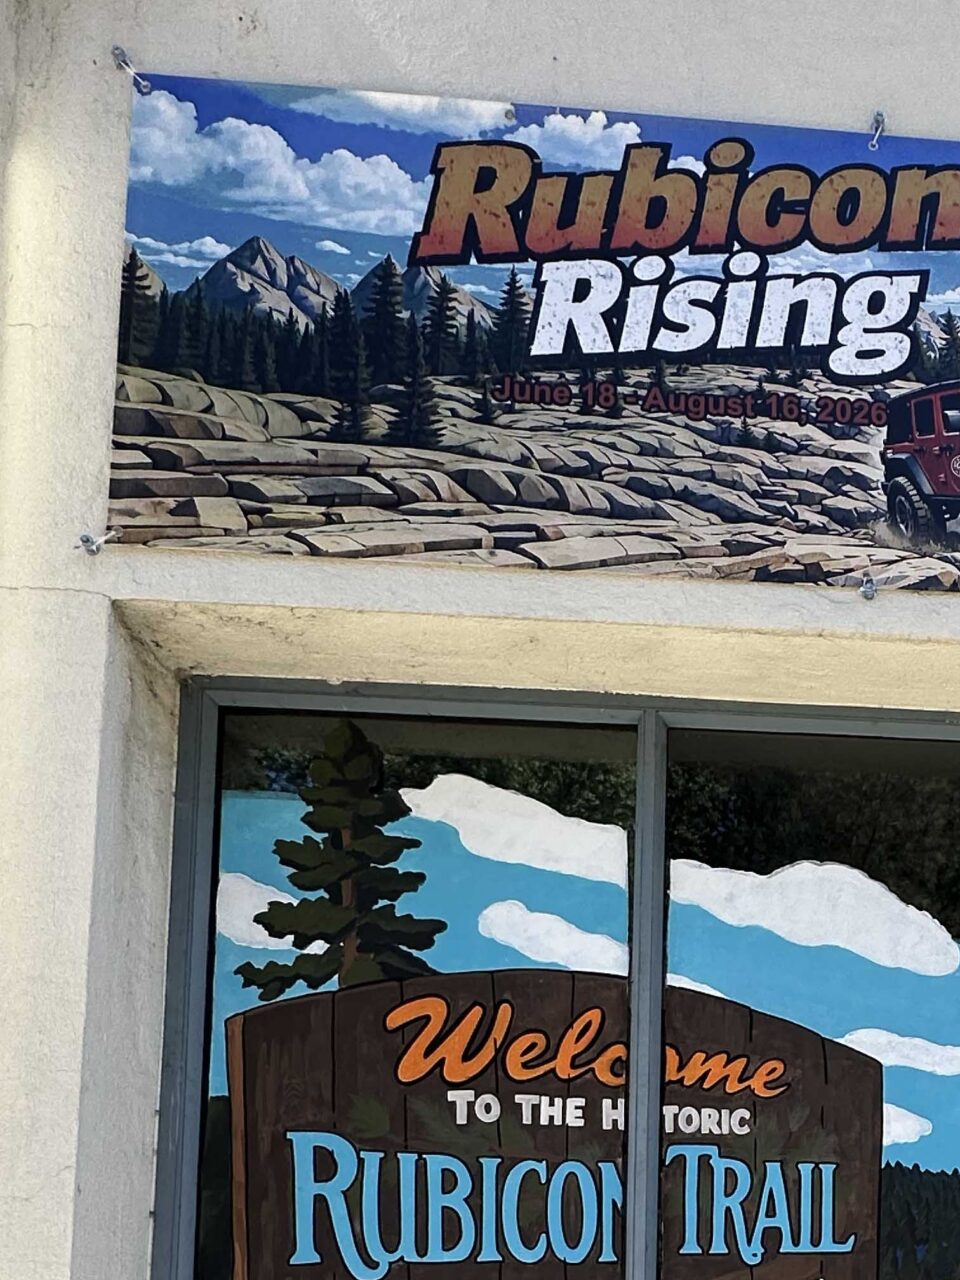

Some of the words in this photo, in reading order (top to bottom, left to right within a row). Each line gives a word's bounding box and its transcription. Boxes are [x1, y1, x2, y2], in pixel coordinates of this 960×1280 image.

[529, 254, 922, 378] Rising
[492, 375, 572, 405] June
[581, 381, 617, 409] 18
[641, 385, 756, 421] August
[765, 392, 806, 425] 16,
[817, 396, 888, 426] 2026
[447, 1089, 501, 1126] TO
[514, 1094, 586, 1127] THE
[602, 1098, 751, 1135] HTORIC
[665, 1144, 856, 1266] TRAIL
